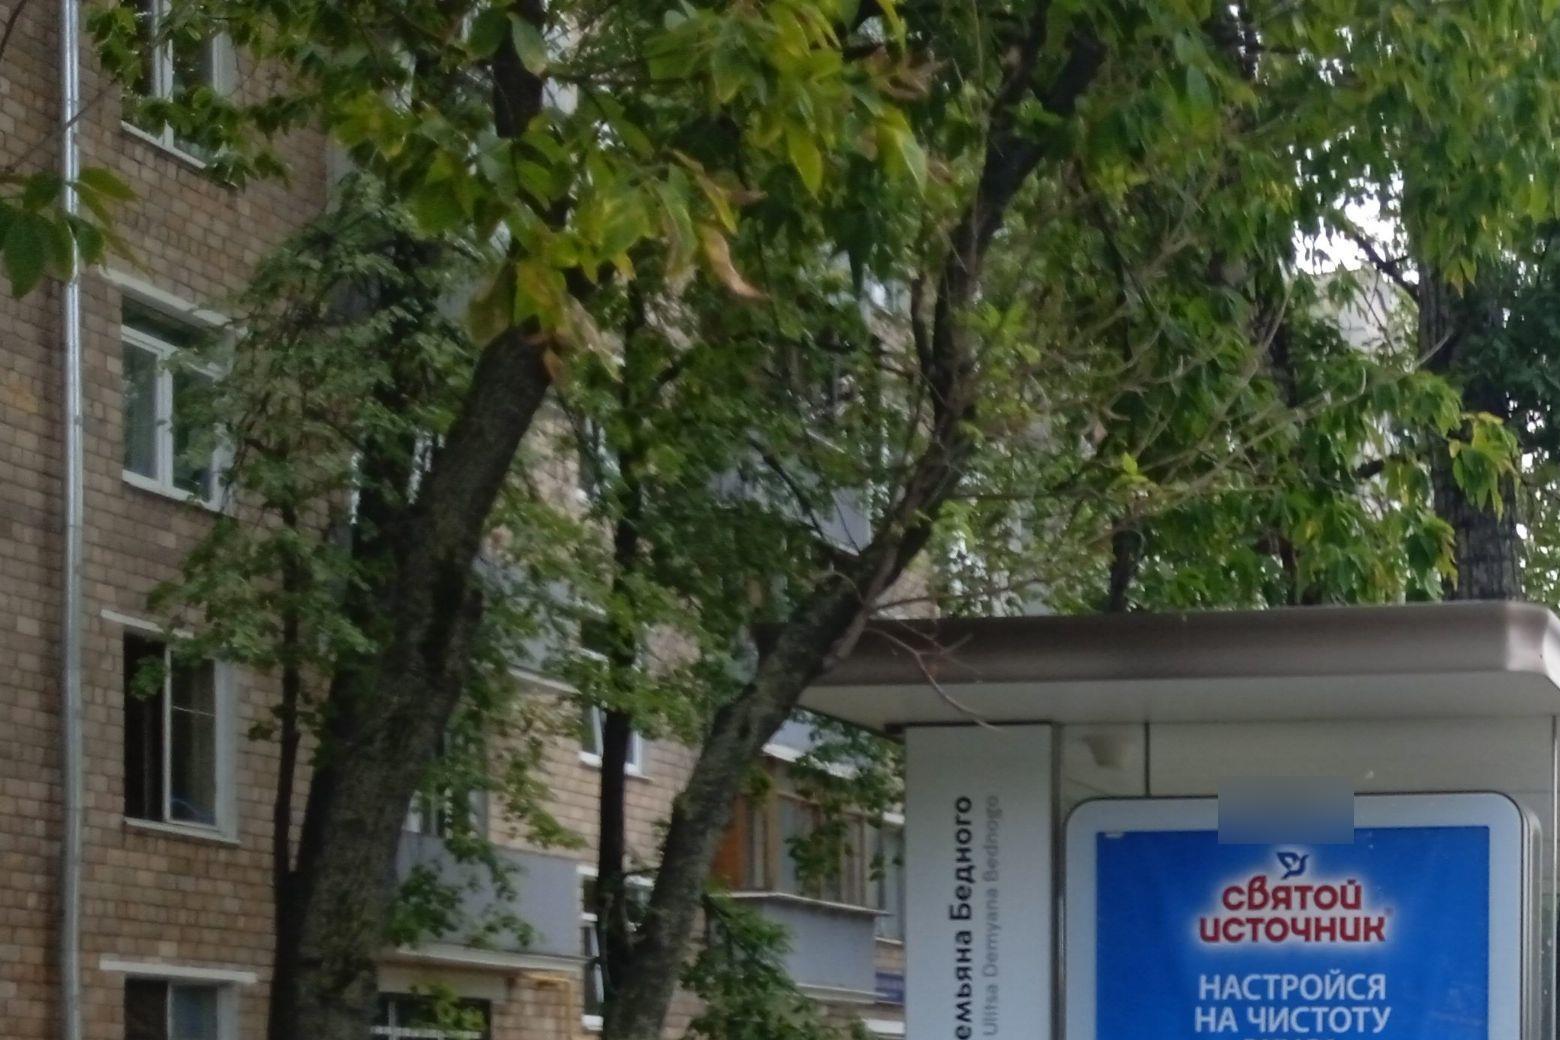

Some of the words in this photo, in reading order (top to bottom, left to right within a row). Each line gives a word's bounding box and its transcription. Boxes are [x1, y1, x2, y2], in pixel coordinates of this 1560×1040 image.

[949, 796, 978, 920] Бедного
[984, 886, 1002, 977] Demyana
[984, 984, 998, 1036] Ulitsa
[1200, 969, 1386, 1001] НАСТРОЙСЯ
[1195, 1007, 1238, 1033] НА
[1247, 1006, 1391, 1033] ЧИСТОТУ
